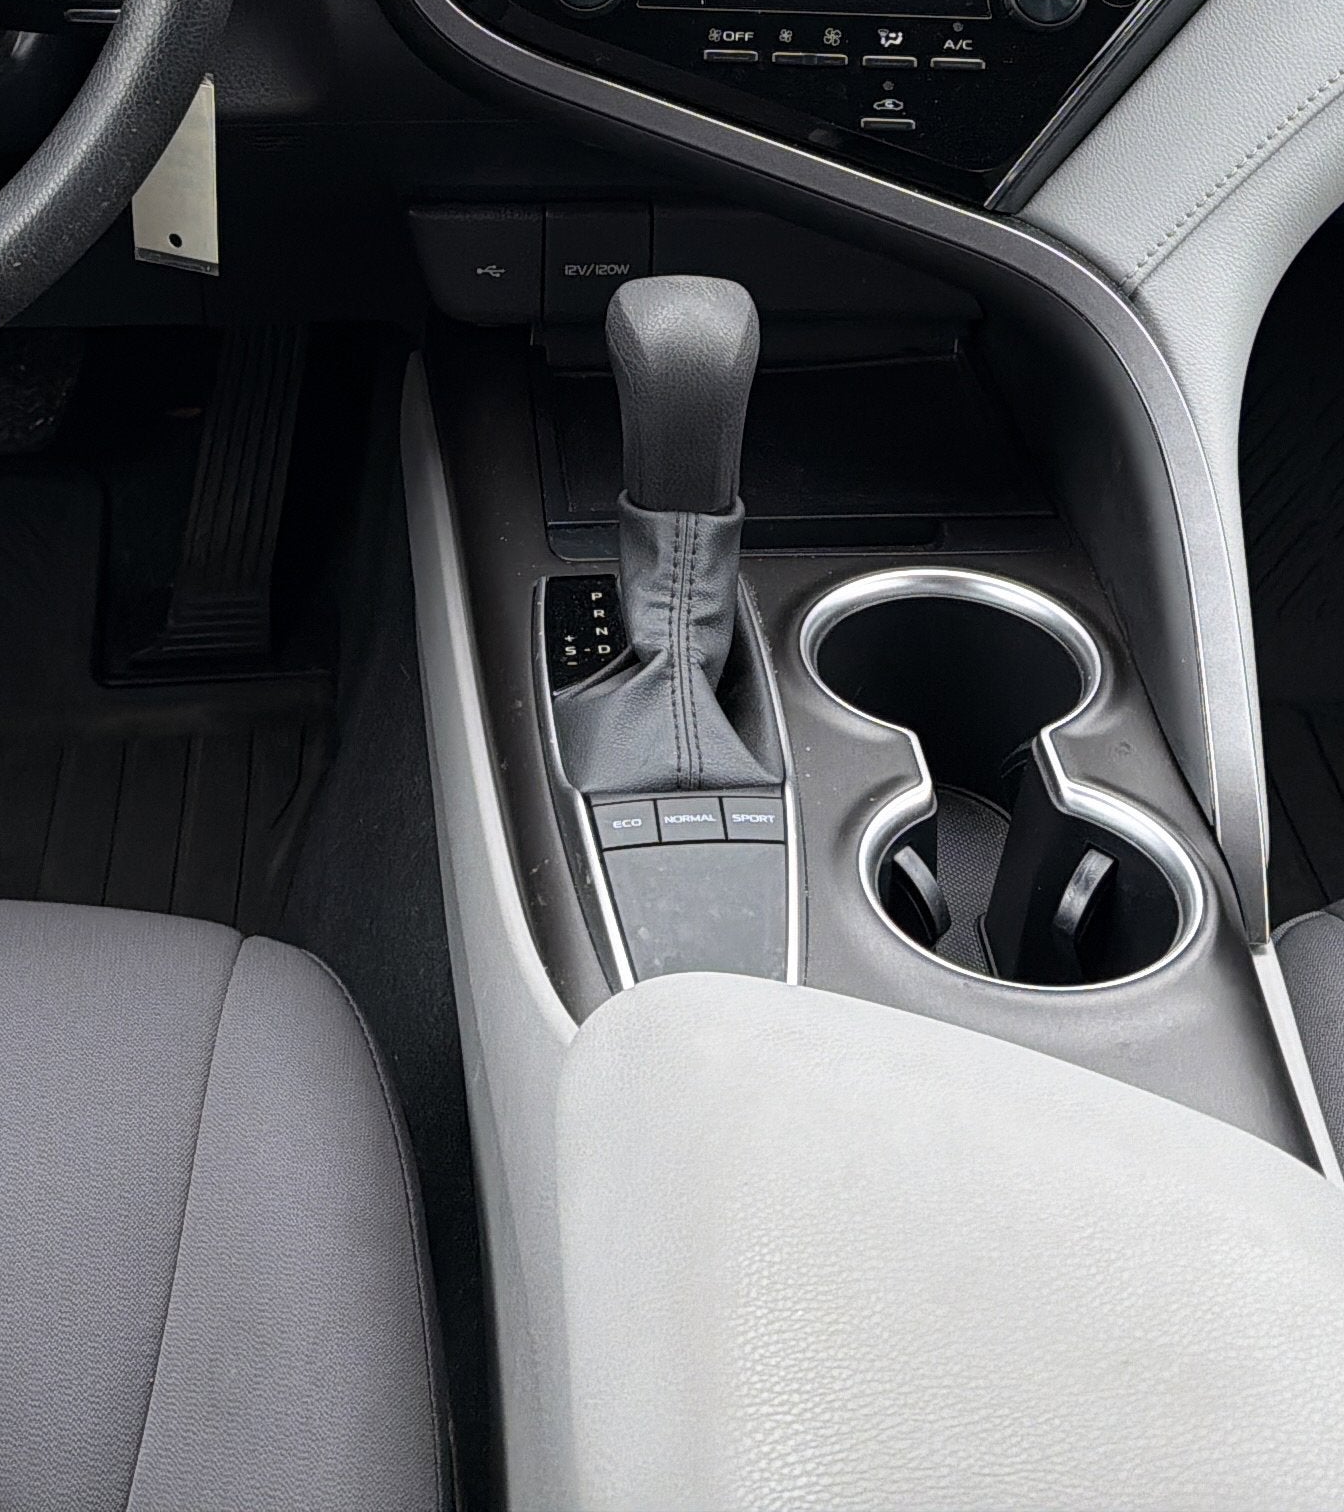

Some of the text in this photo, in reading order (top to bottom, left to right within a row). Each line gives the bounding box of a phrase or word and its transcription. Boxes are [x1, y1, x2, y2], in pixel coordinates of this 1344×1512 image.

[722, 31, 754, 42] OFF
[943, 38, 973, 50] A/C
[564, 263, 630, 277] 12V/120W
[591, 592, 603, 601] P
[593, 609, 606, 618] R
[596, 627, 609, 636] N
[597, 644, 611, 654] D
[612, 818, 643, 829] ECO
[663, 813, 717, 824] NORMAL
[731, 814, 776, 824] SPORT
